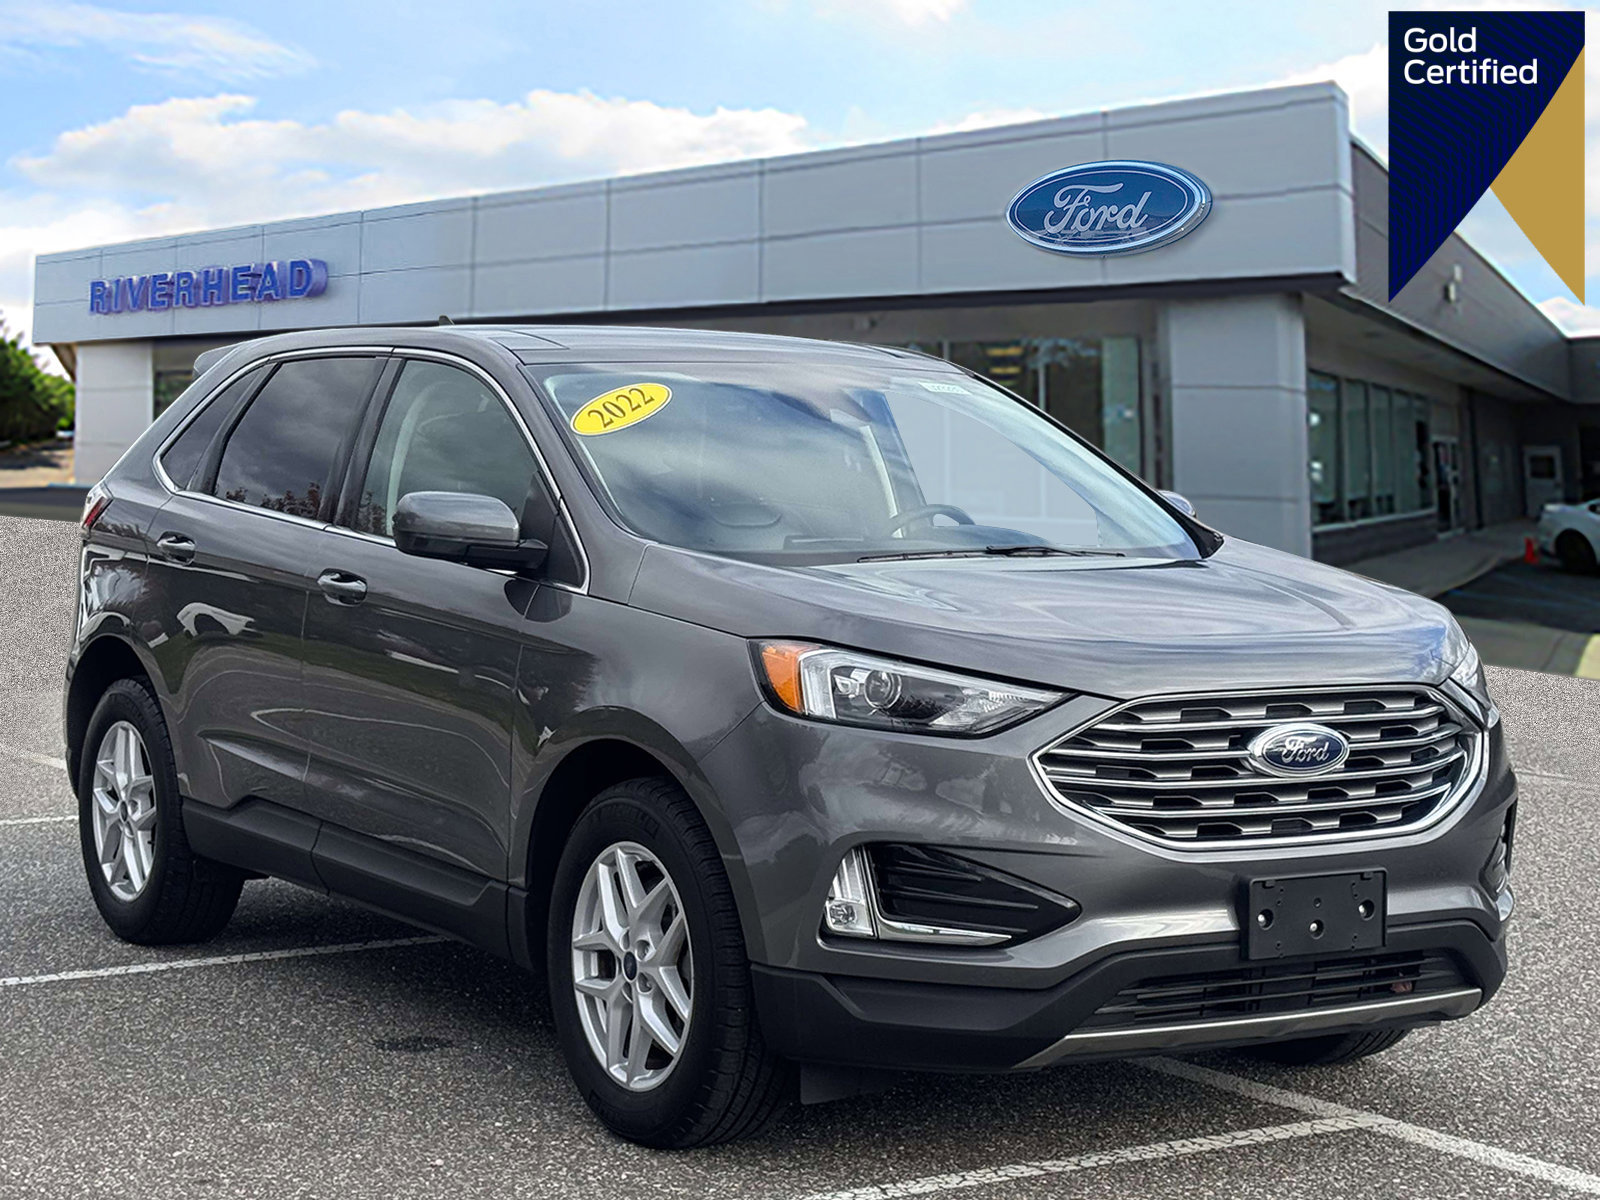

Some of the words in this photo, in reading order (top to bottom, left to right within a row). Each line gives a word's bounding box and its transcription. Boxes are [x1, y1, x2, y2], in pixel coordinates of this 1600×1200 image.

[1043, 182, 1152, 234] Ford
[90, 259, 322, 314] RIVERHEAD
[587, 388, 655, 428] 2022
[1281, 736, 1330, 763] Ford
